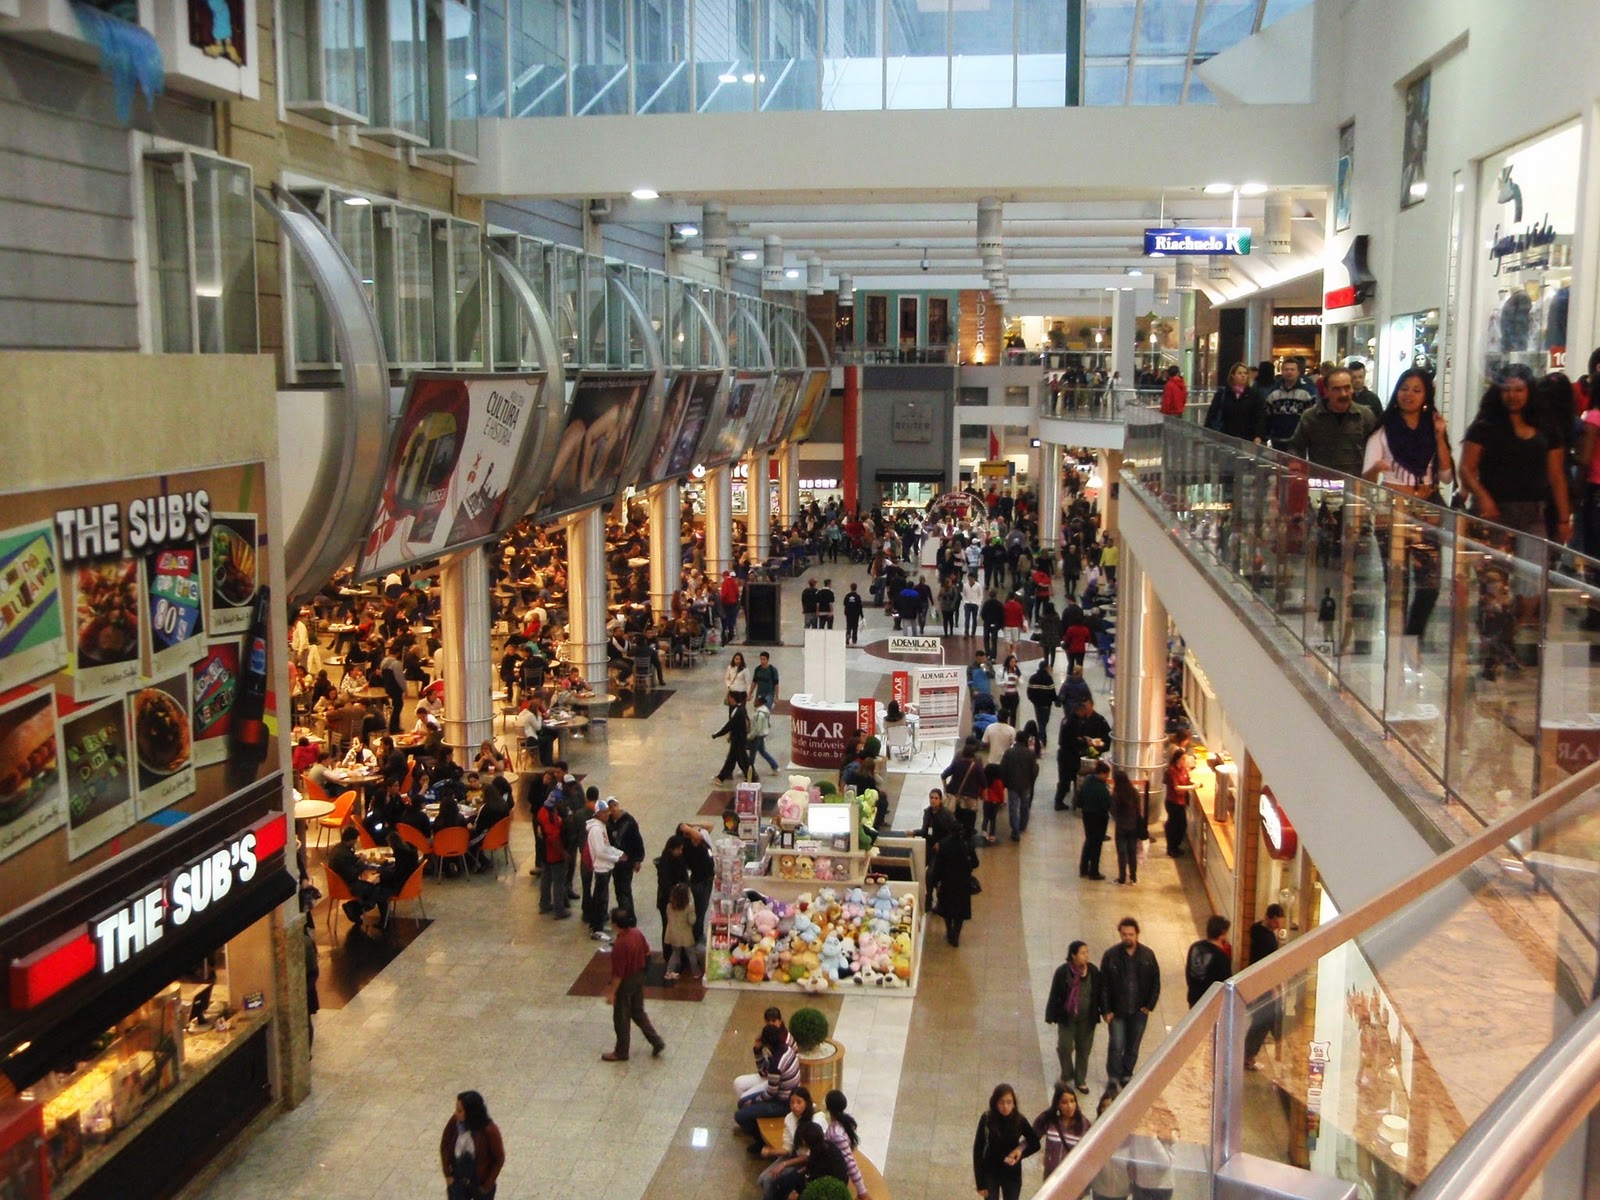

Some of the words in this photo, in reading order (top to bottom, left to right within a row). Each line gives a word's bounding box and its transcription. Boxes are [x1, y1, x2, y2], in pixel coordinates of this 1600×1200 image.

[1154, 236, 1223, 251] Riachuelo
[486, 390, 521, 430] CULTURA
[56, 503, 121, 561] THE
[128, 489, 211, 549] SUB'S
[890, 638, 938, 648] ADEMILAR
[920, 671, 959, 680] ADEMILAR
[97, 887, 164, 974] THE
[173, 833, 258, 925] SUB'S
